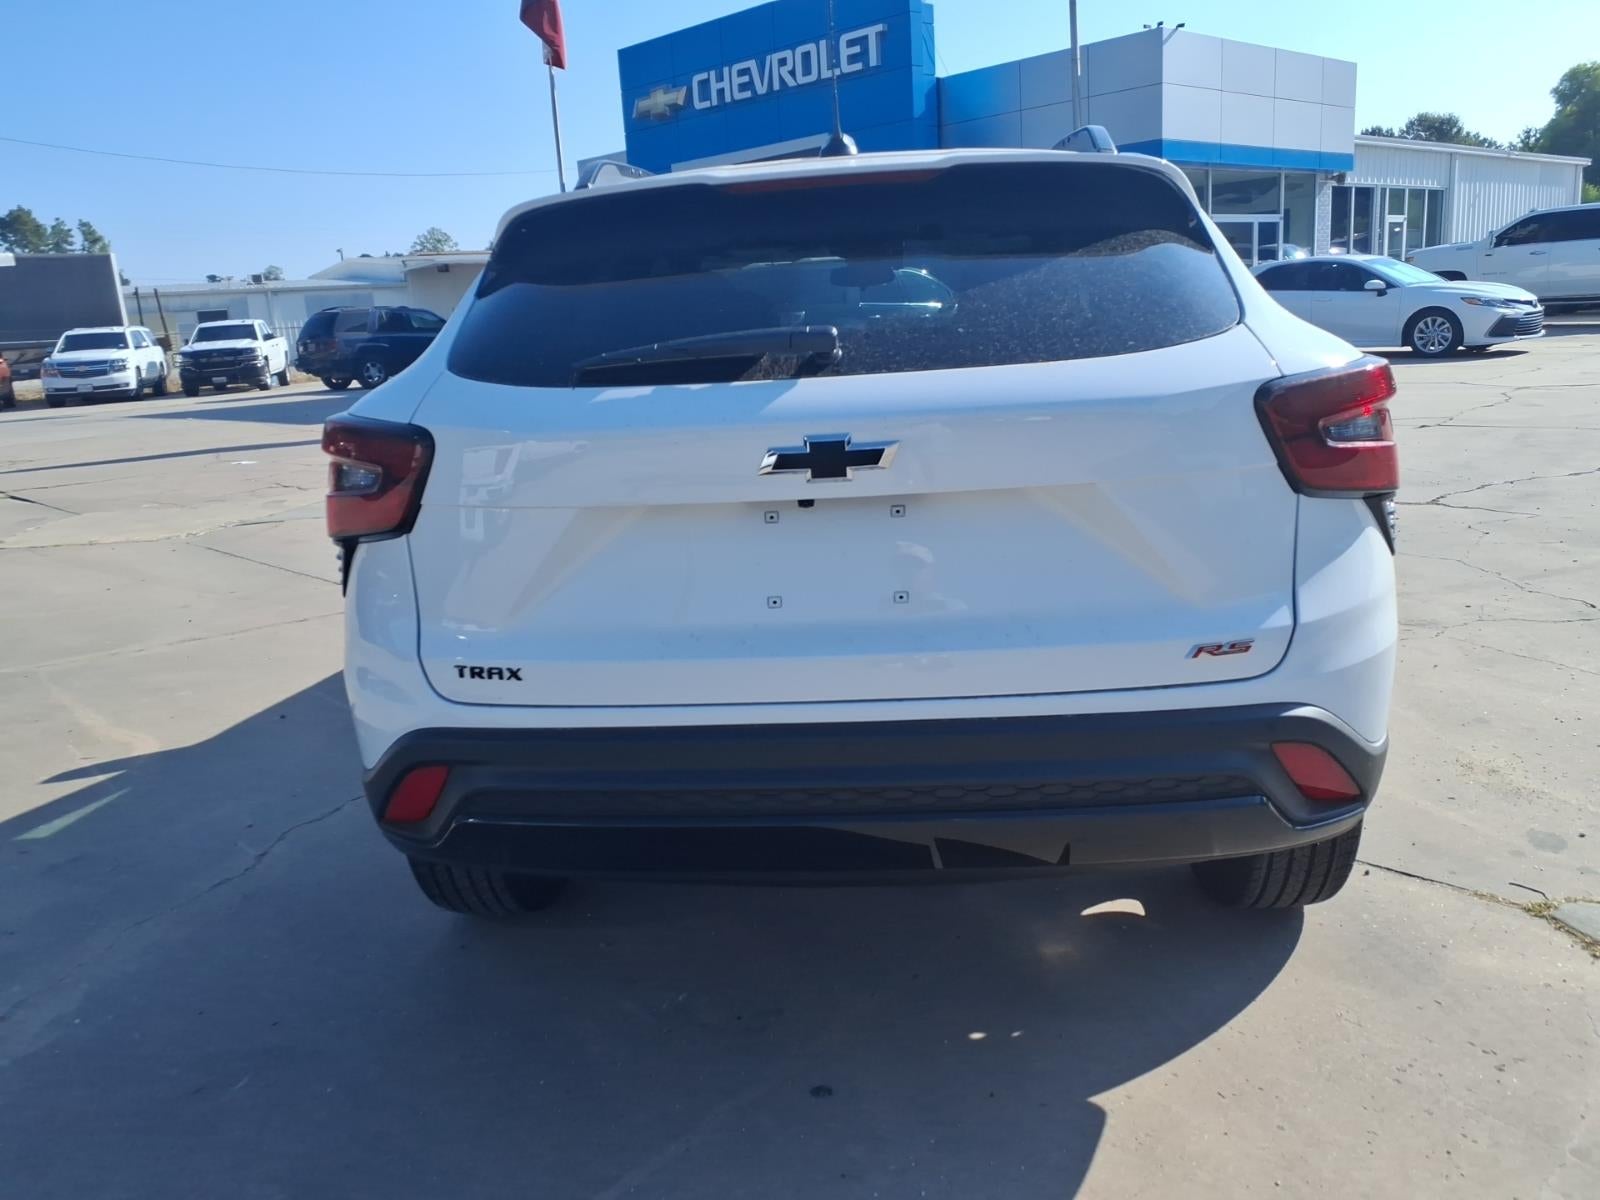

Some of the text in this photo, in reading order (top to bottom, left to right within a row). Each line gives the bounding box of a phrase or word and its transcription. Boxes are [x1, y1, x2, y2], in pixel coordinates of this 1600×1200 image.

[692, 23, 887, 110] CHEVROLET
[1185, 638, 1255, 659] RS
[453, 664, 523, 681] TRAX
